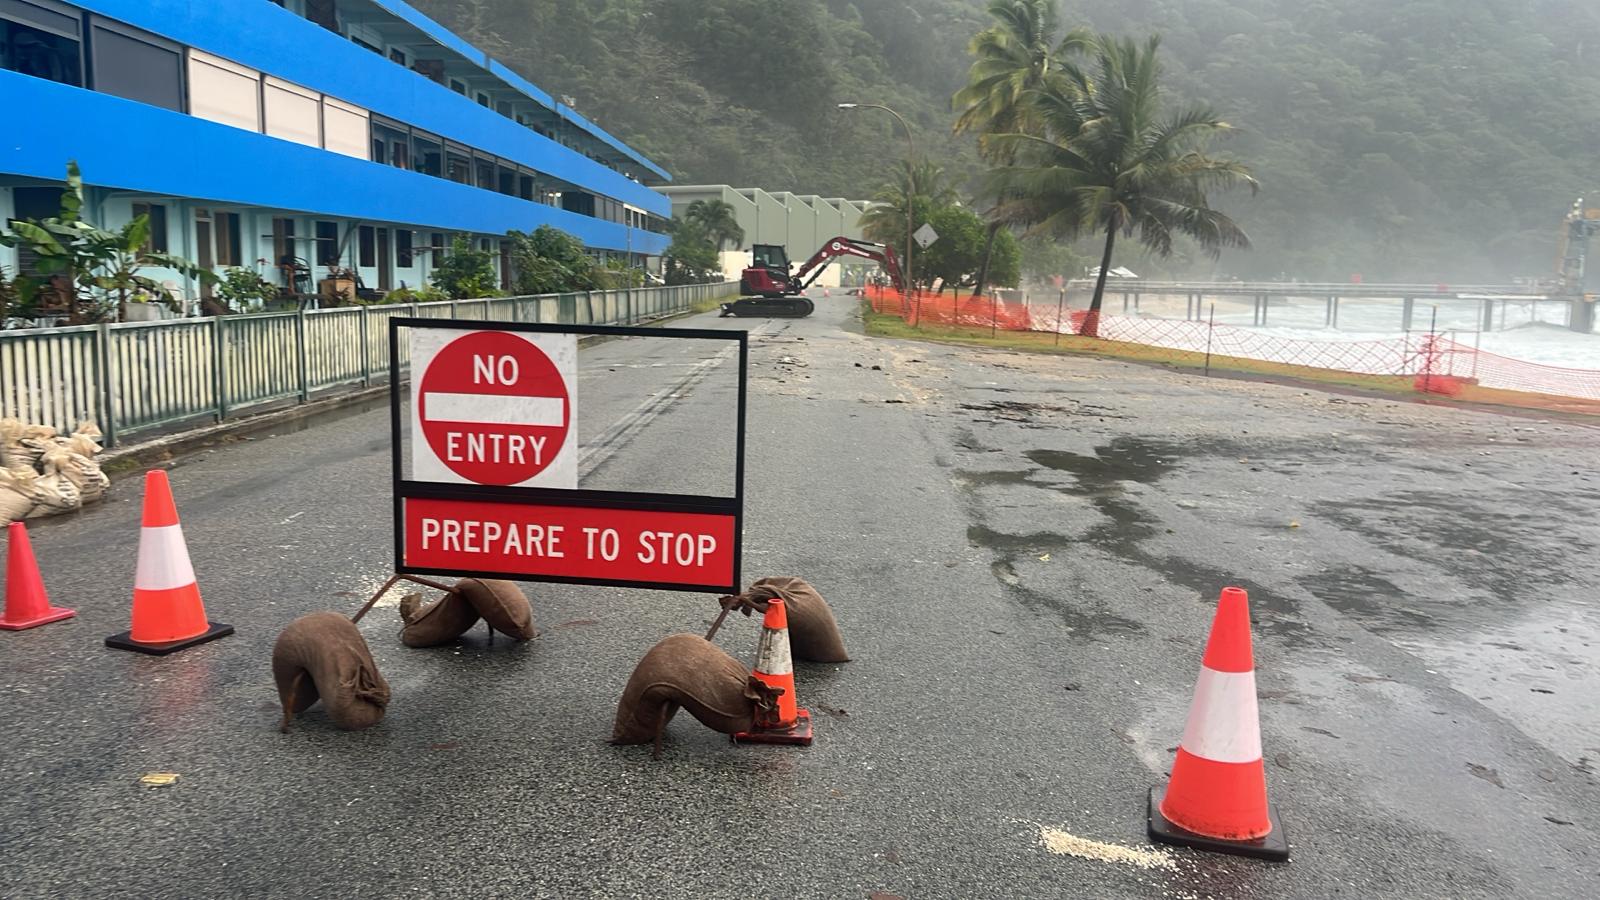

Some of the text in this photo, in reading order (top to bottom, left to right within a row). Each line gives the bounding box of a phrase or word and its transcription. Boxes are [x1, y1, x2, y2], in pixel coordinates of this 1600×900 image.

[474, 355, 519, 386] NO
[446, 432, 548, 465] ENTRY
[422, 518, 717, 567] PREPARE TO STOP
